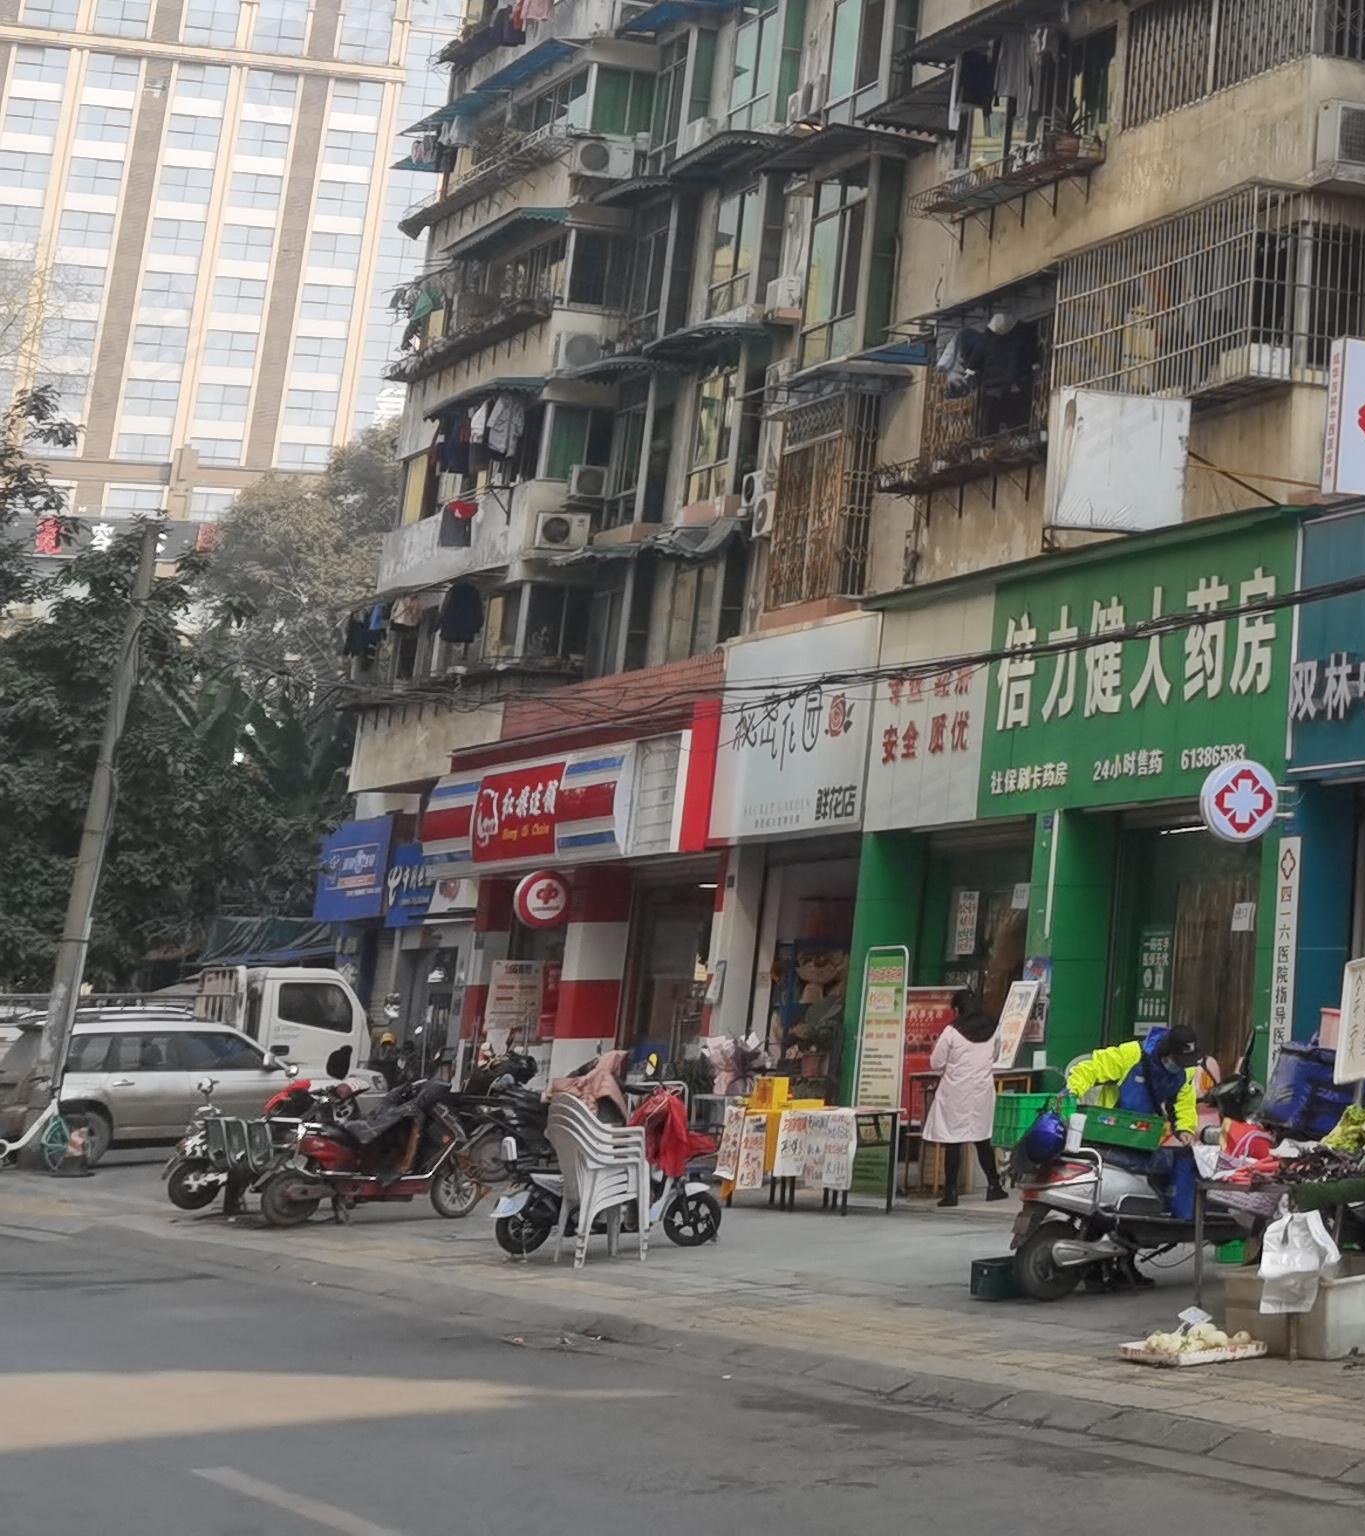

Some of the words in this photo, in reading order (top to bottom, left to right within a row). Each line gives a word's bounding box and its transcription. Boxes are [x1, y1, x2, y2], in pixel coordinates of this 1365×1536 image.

[990, 761, 1069, 795] 社保刷卡药房
[1092, 749, 1165, 782] 24小时售药
[814, 784, 857, 822] 鲜花店
